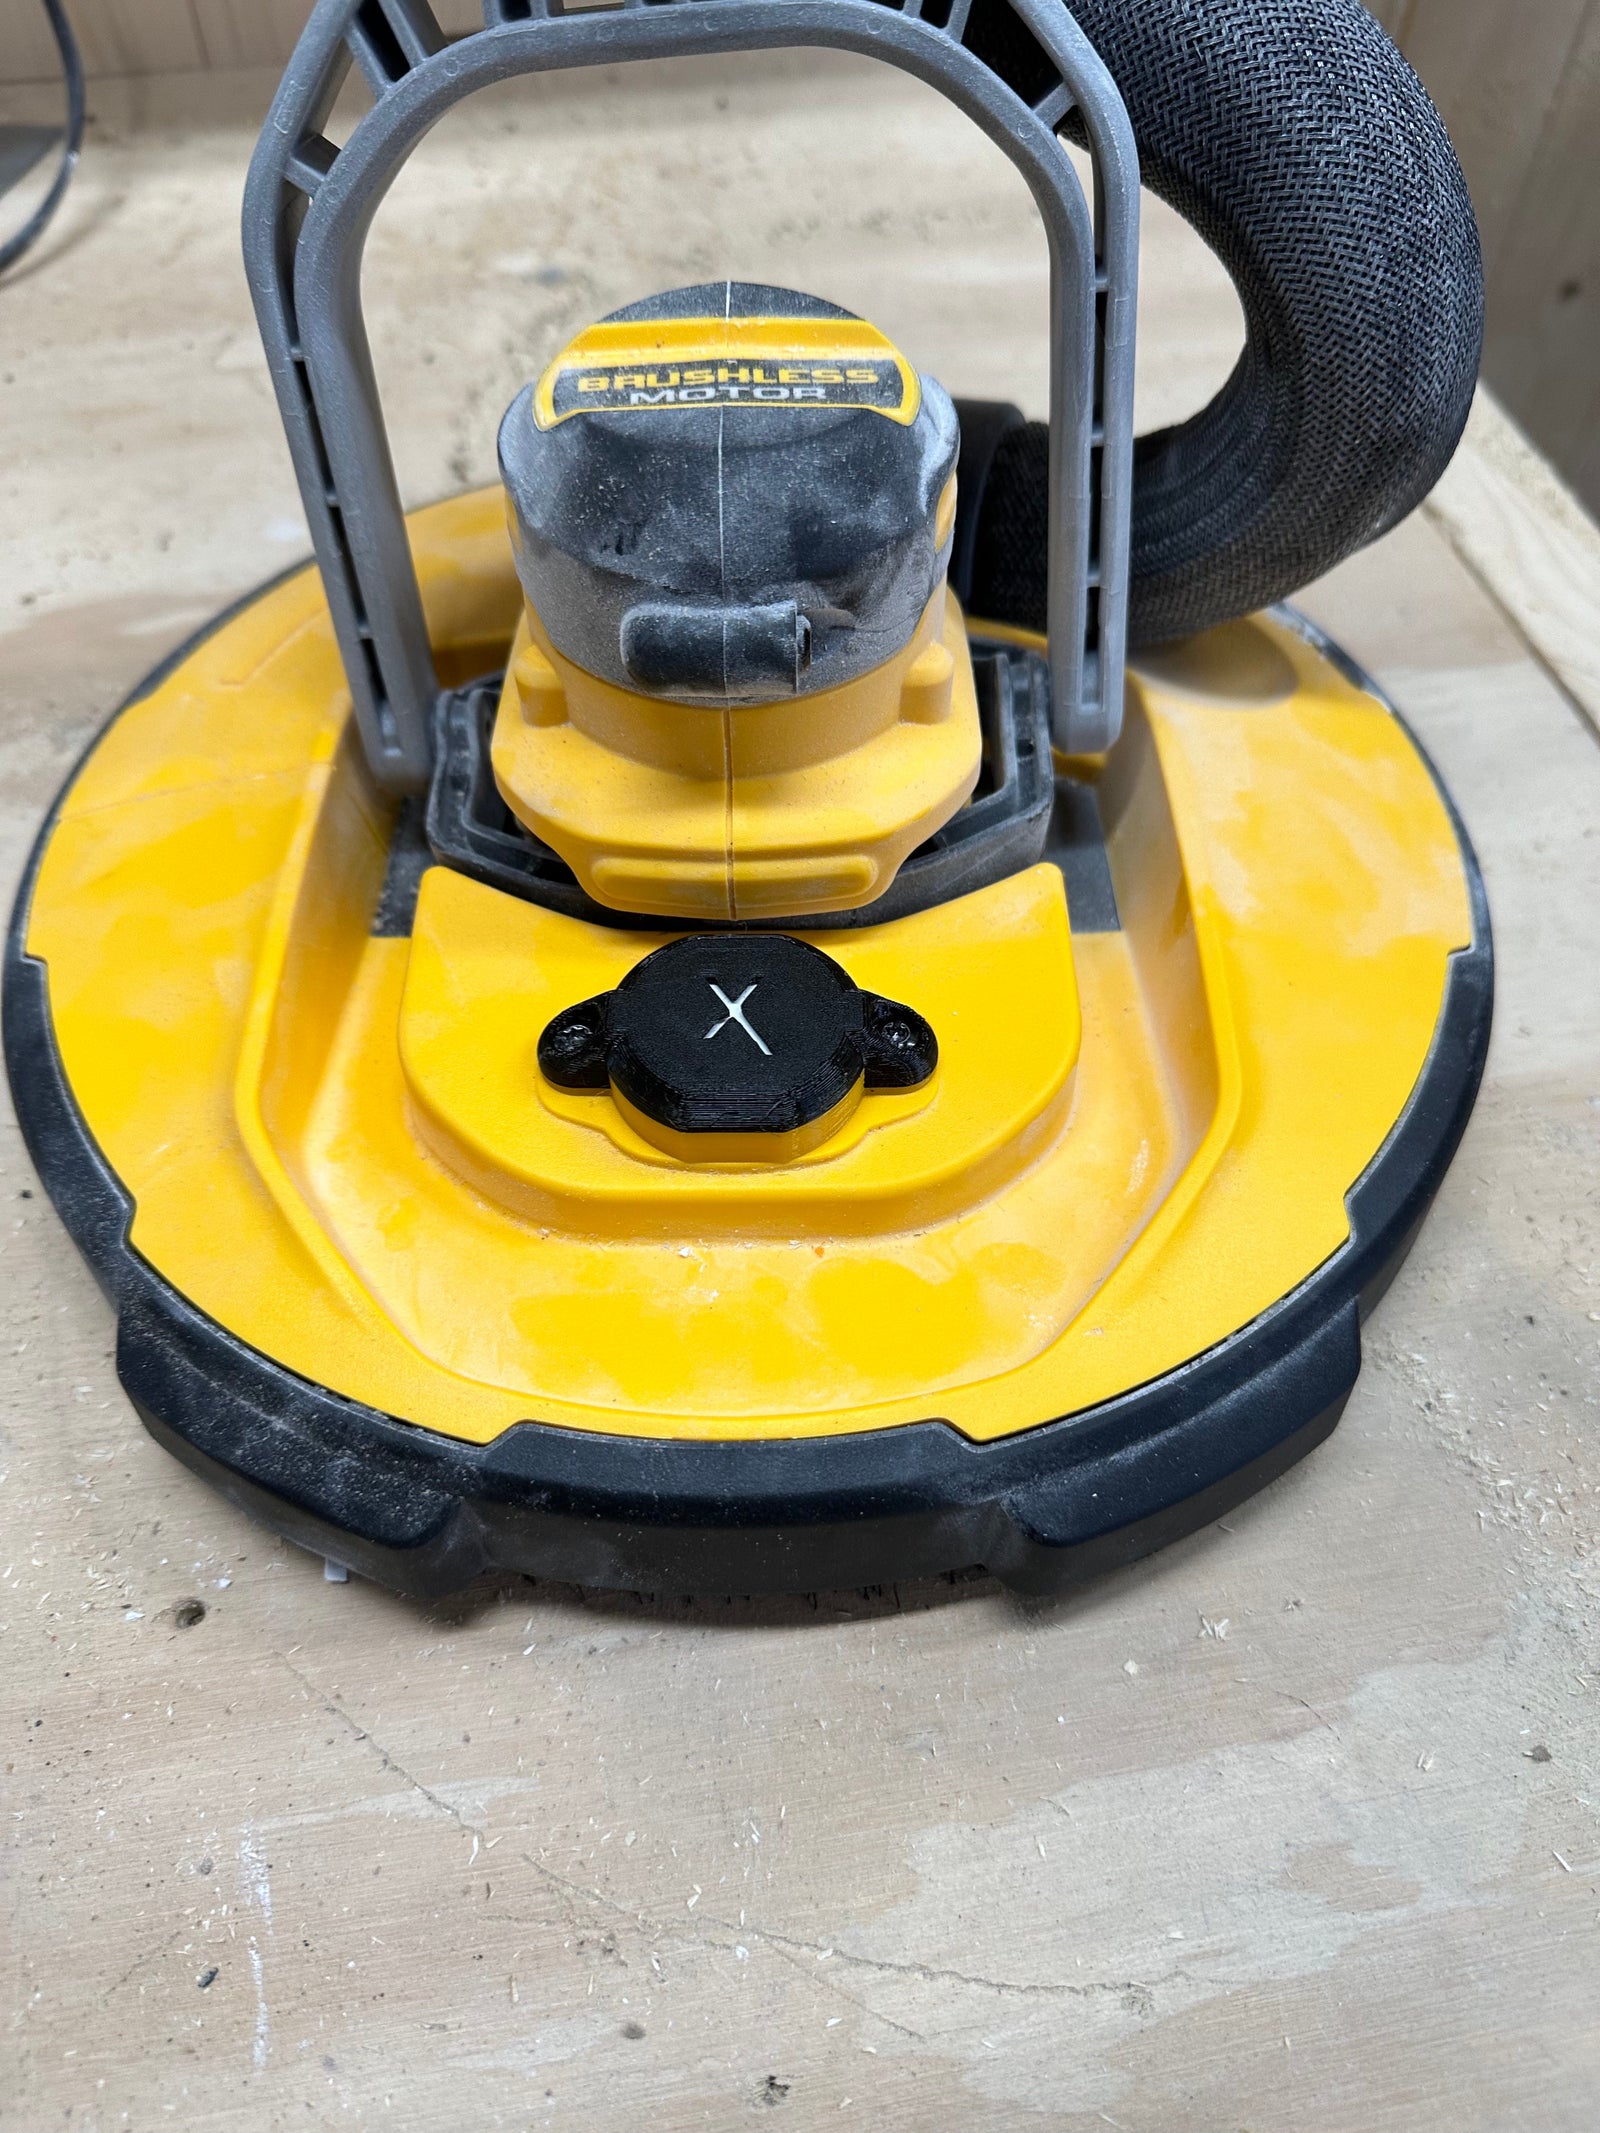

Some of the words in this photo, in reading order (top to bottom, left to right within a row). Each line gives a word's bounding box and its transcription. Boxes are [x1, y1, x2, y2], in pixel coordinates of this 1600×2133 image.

[577, 367, 880, 393] BRUSHLESS
[629, 386, 827, 405] MOTOR
[702, 979, 773, 1056] X
